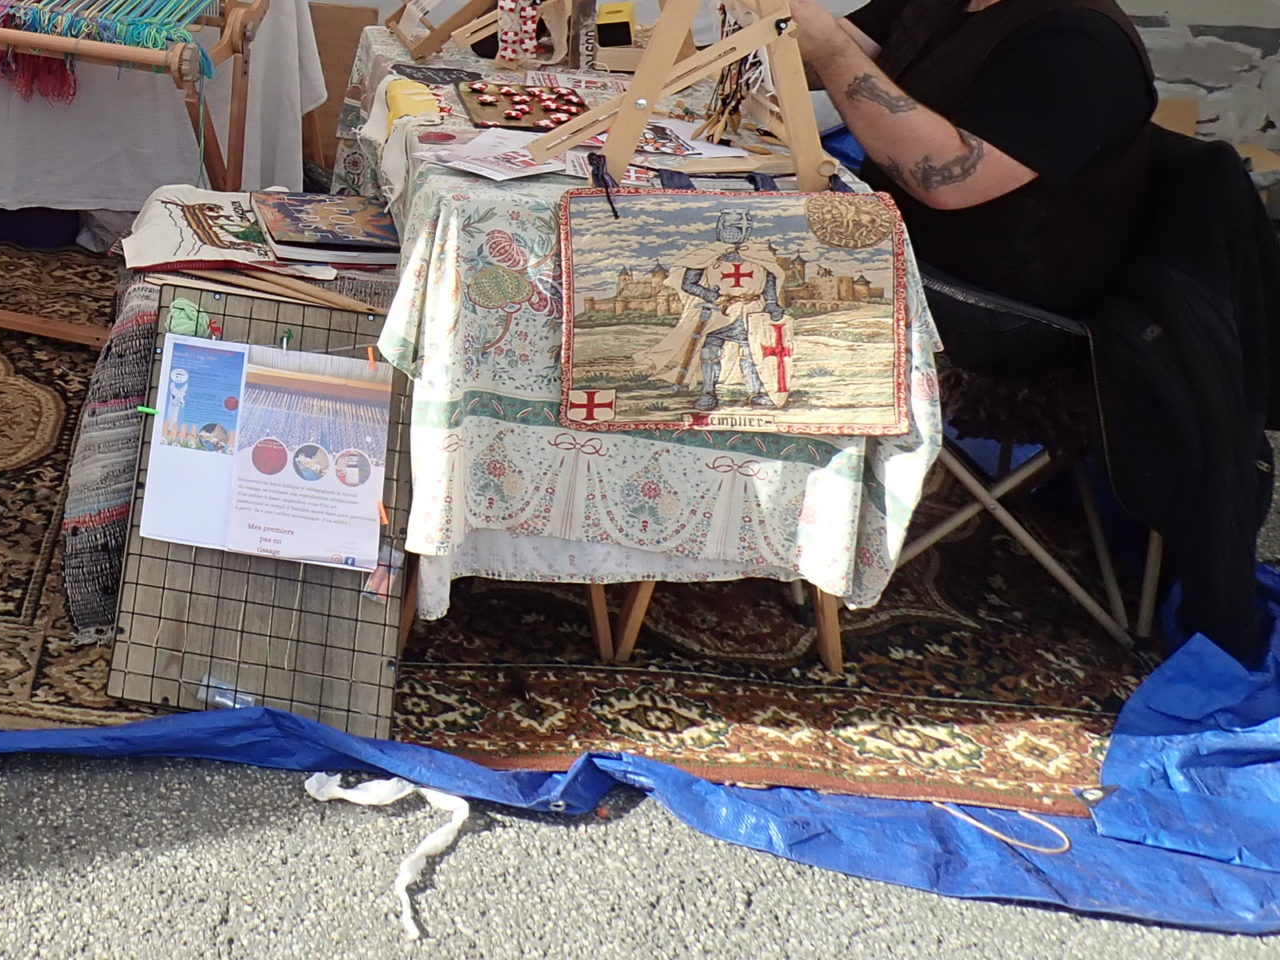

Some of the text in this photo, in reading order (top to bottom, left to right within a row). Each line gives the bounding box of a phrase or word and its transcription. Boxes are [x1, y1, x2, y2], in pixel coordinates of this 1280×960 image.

[248, 523, 295, 536] Mes premiers
[259, 536, 272, 544] pas
[256, 545, 281, 557] tissage
